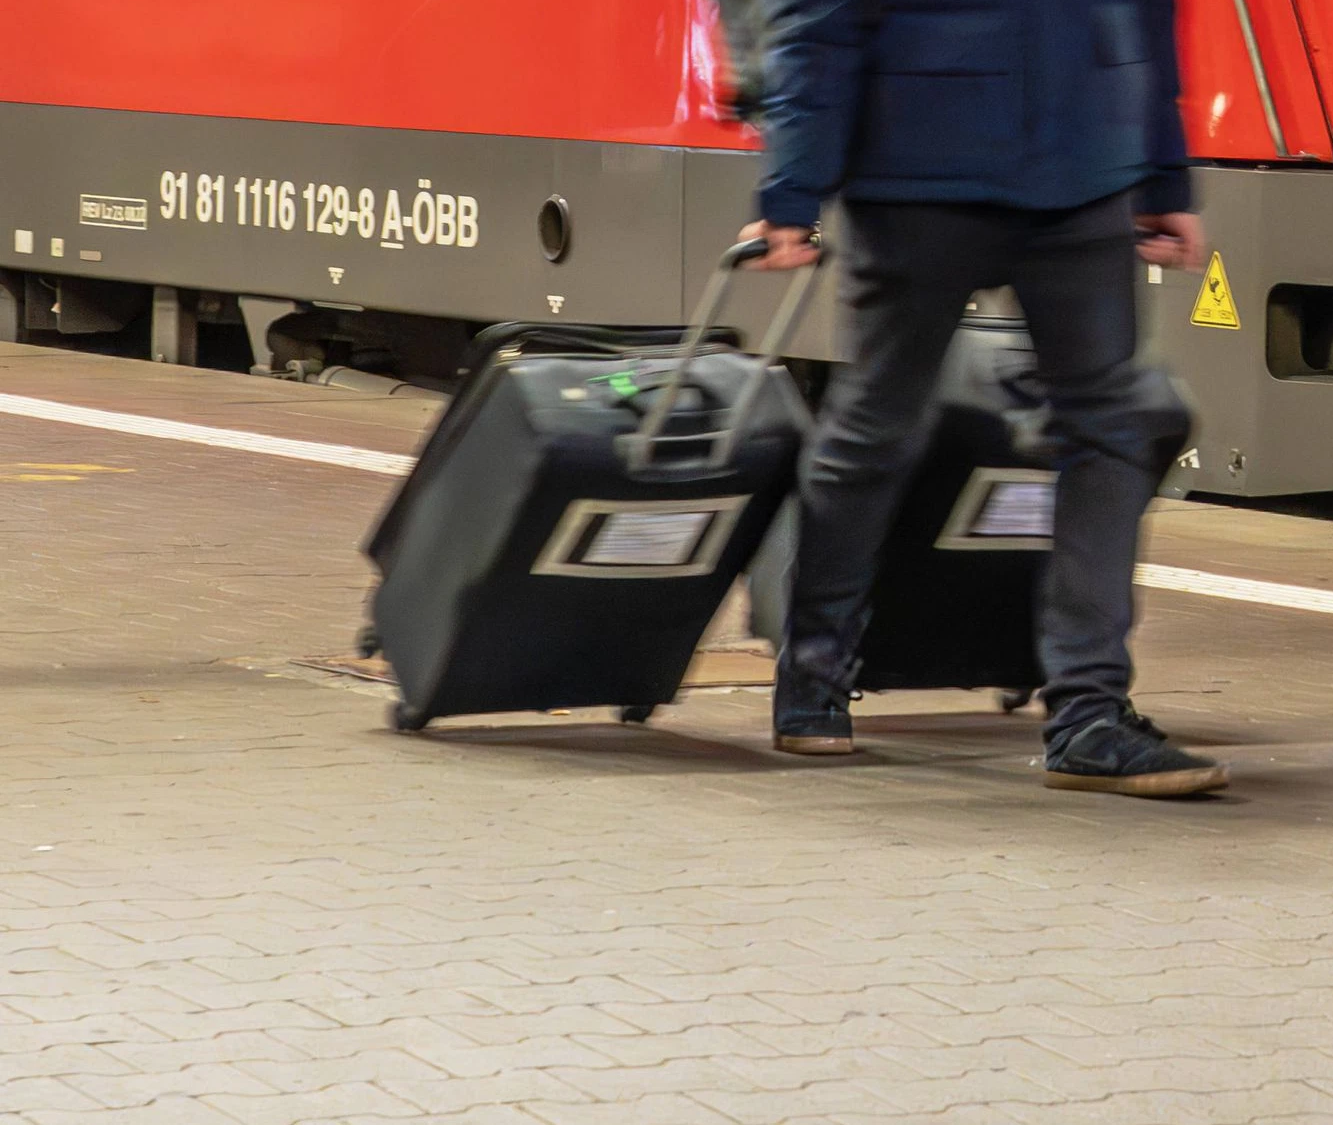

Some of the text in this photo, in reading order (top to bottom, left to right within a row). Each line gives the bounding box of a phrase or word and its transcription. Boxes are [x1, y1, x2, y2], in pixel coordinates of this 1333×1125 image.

[160, 171, 188, 220] 91
[196, 174, 224, 223] 81
[234, 177, 296, 231] 1116
[303, 183, 375, 239] 129-8
[380, 178, 479, 249] A-ÖBB
